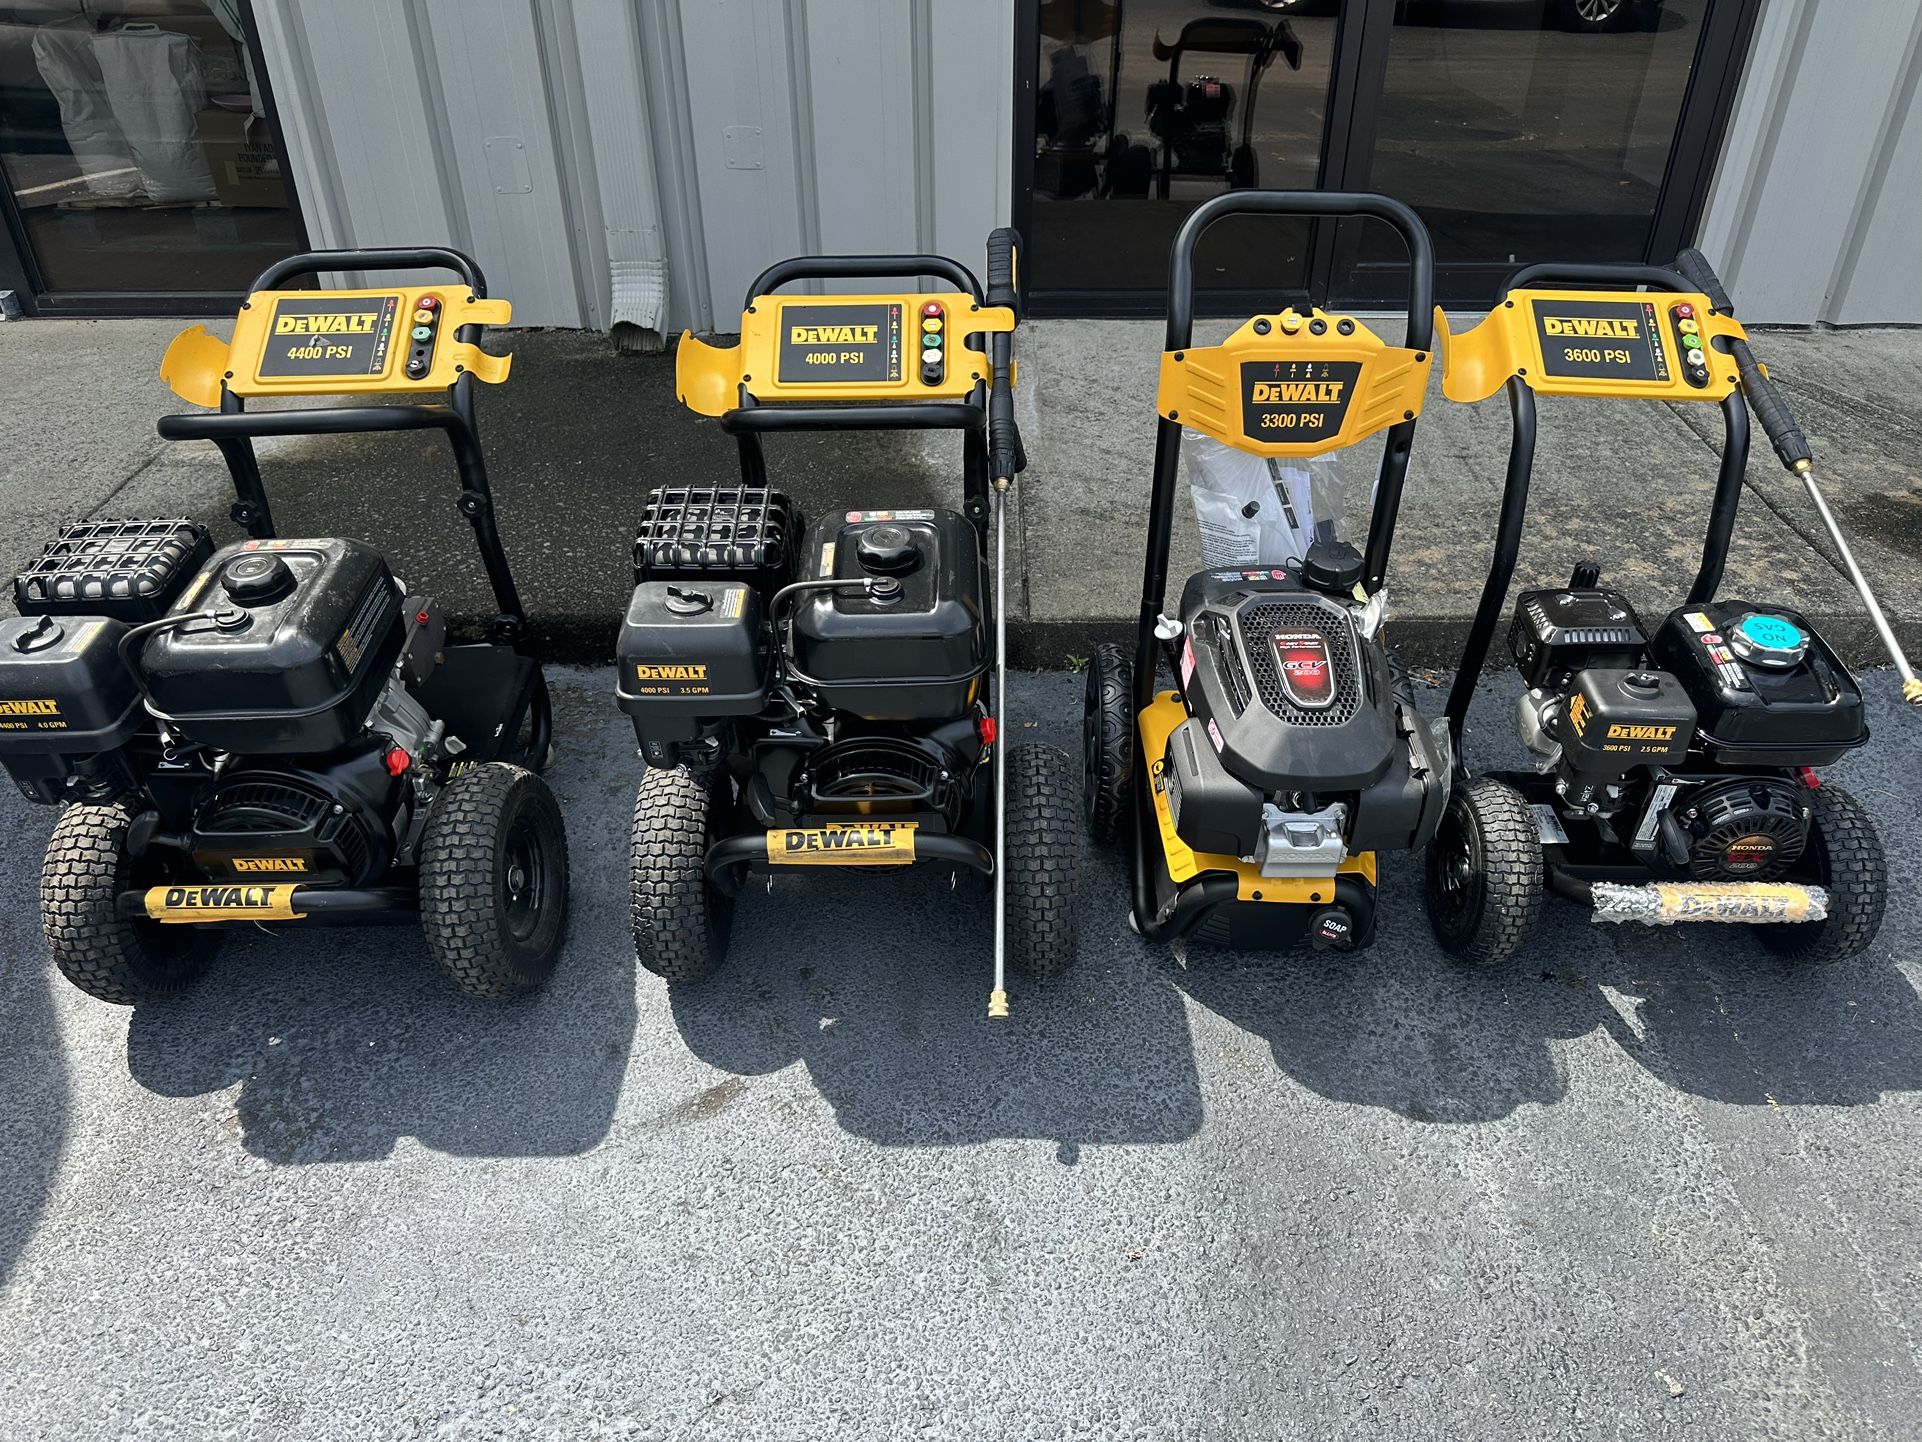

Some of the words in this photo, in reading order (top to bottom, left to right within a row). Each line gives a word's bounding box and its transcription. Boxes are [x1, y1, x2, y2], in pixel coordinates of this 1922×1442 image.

[275, 315, 378, 333] DEWALT
[1544, 318, 1640, 337] DEWALT
[791, 326, 878, 343] DEWALT
[286, 346, 322, 360] 4400
[325, 346, 353, 359] PSI
[805, 352, 837, 365] 4000
[840, 352, 864, 364] PSI
[1563, 348, 1601, 363] 3600
[1603, 349, 1632, 364] PSI
[1252, 384, 1344, 401] DEWALT
[1260, 413, 1297, 428] 3300
[1299, 413, 1325, 428] PSI
[1753, 621, 1787, 632] GAS
[1762, 632, 1788, 643] NO
[637, 665, 707, 679] DEWALT
[1282, 660, 1328, 670] GCV
[49, 721, 68, 729] GPM
[1607, 725, 1677, 740] DEWALT
[1602, 744, 1618, 752] 3600
[785, 829, 897, 852] DEWALT
[232, 859, 307, 872] DEWALT
[165, 887, 277, 907] DEWALT
[1323, 919, 1348, 933] SOAP
